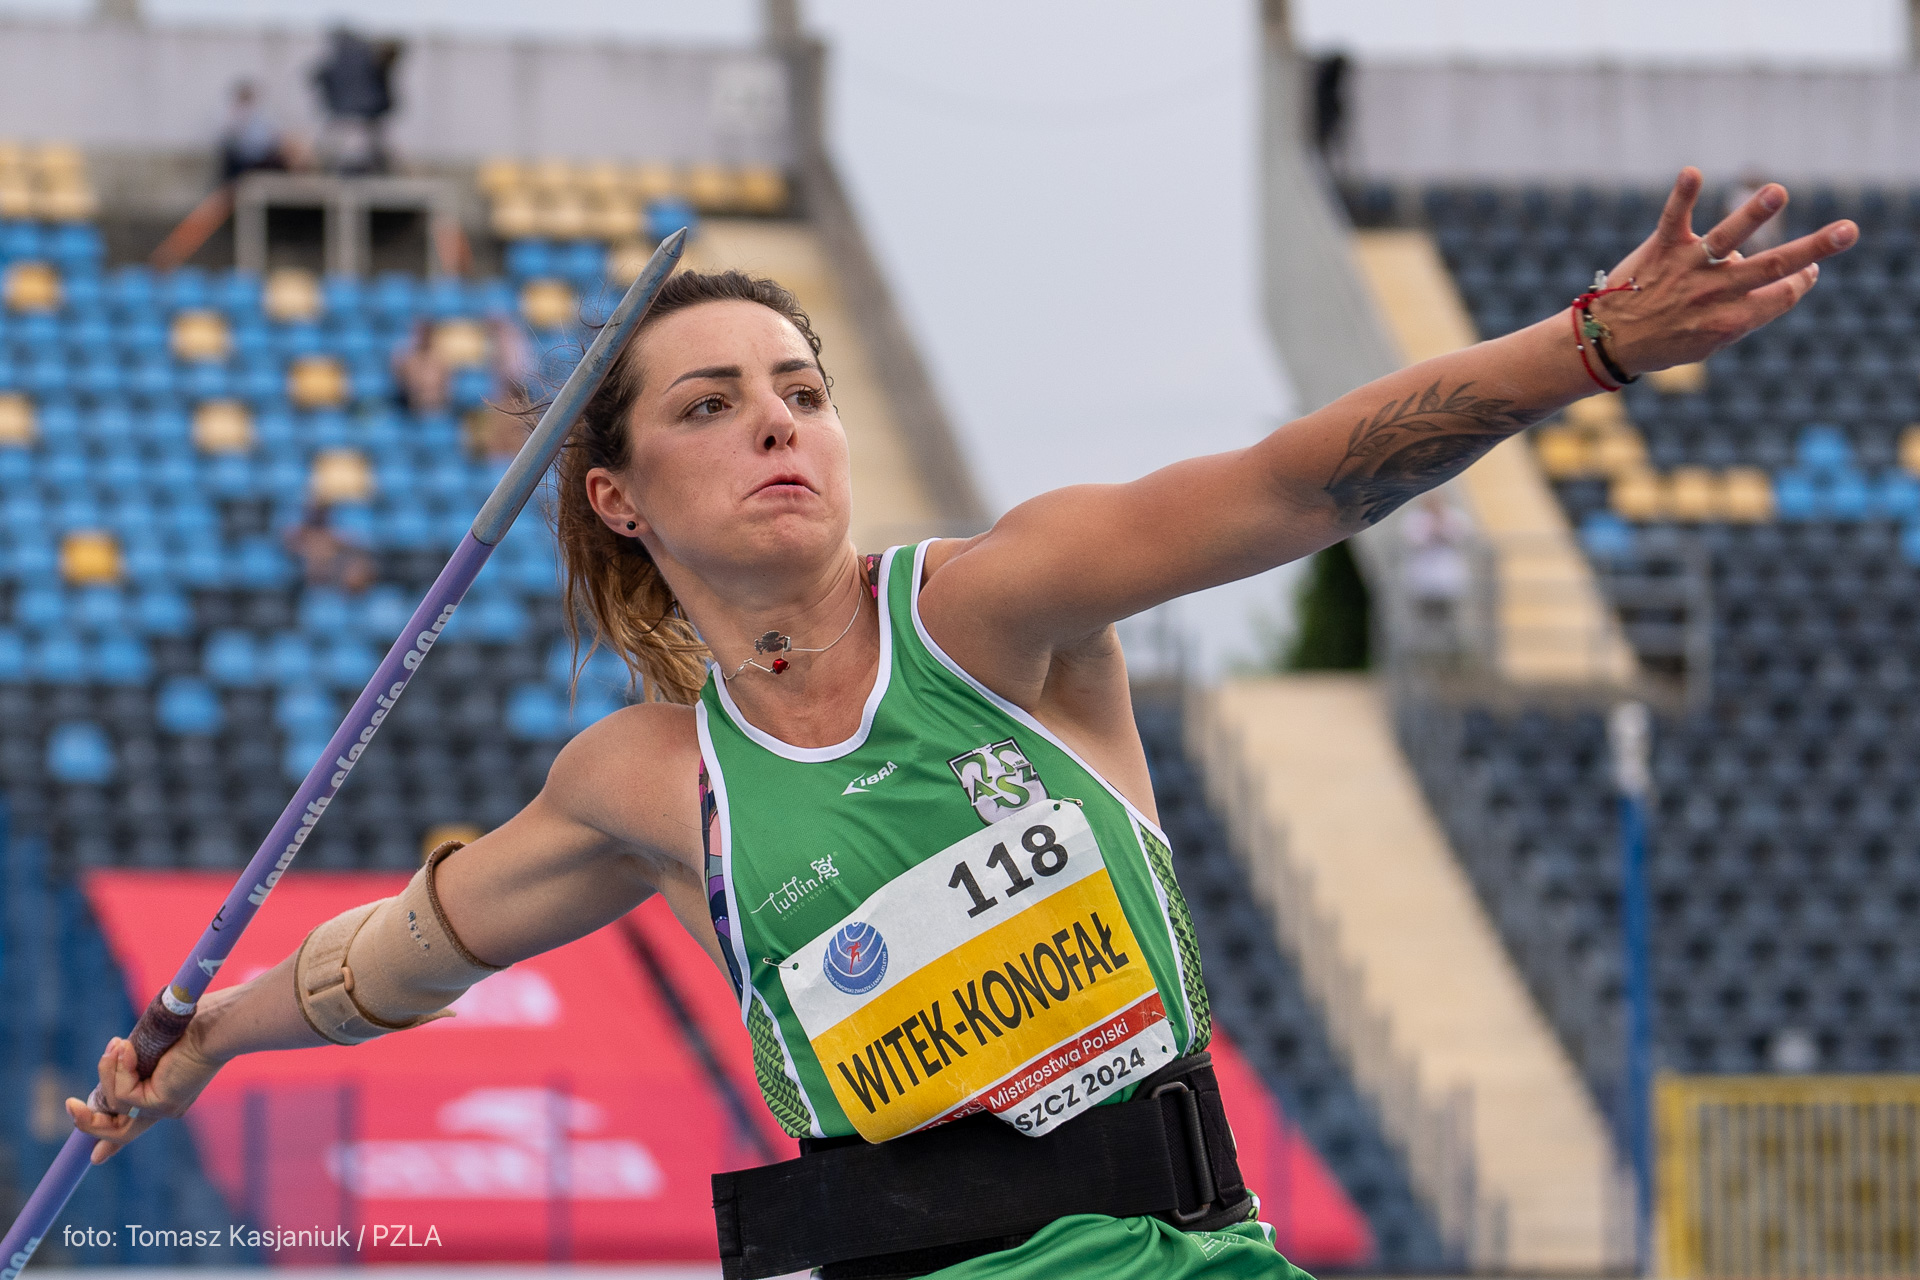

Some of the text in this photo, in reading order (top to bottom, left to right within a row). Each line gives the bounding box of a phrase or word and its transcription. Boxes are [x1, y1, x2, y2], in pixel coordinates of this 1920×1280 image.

[947, 824, 1069, 918] 118
[836, 911, 1130, 1114] WITEK-KONOFAŁ
[988, 1047, 1082, 1110] Mistrzostwa
[1081, 1018, 1130, 1056] Polski
[1006, 1046, 1146, 1132] SZCZ 2024
